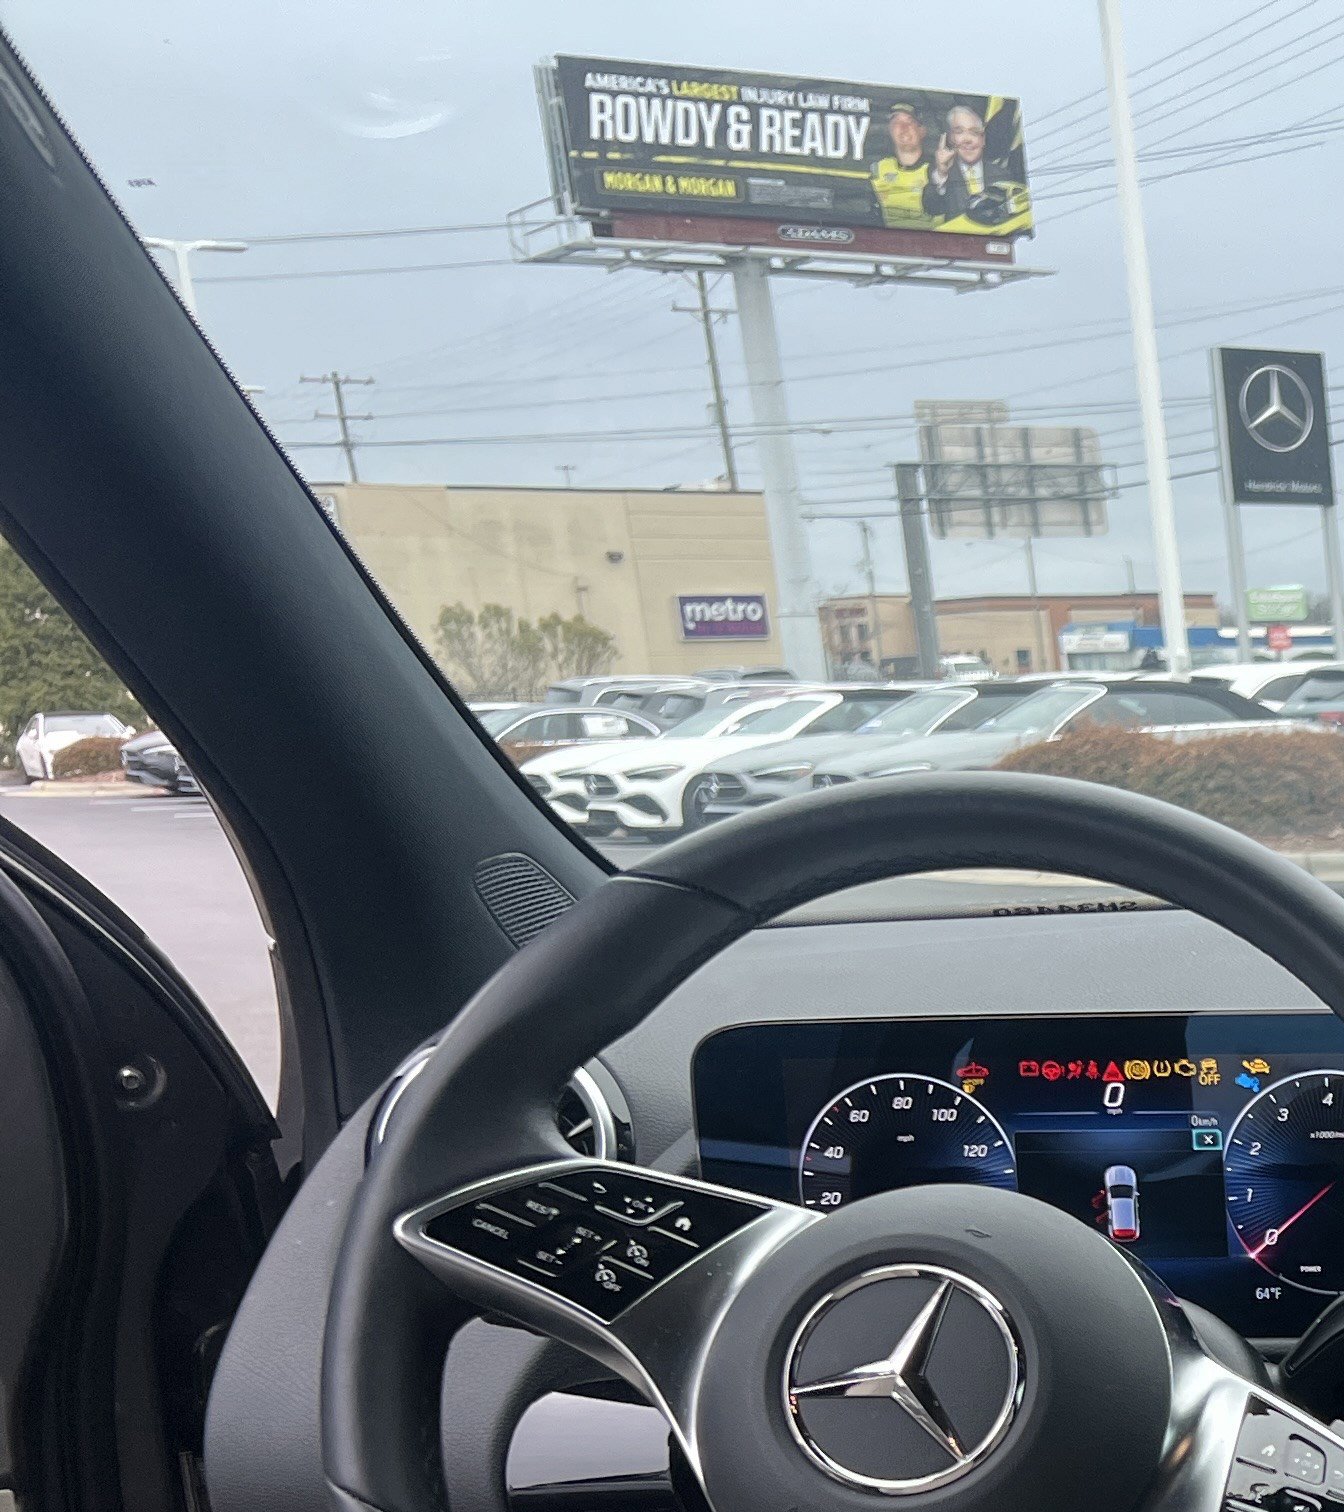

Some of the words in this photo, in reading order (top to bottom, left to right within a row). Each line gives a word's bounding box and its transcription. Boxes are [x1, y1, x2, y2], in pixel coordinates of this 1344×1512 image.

[671, 80, 739, 101] LARGEST
[741, 86, 796, 106] INJURY
[797, 90, 830, 109] LAW
[588, 91, 722, 150] ROWDY
[727, 104, 752, 151] &
[758, 106, 871, 161] READY
[603, 171, 664, 194] MORGAN
[665, 175, 677, 194] &
[677, 176, 737, 198] MORGAN
[682, 597, 764, 627] metro
[1198, 1073, 1221, 1086] OFF
[1103, 1082, 1126, 1108] 0
[1322, 1092, 1334, 1107] 4
[891, 1096, 913, 1110] 80
[849, 1109, 870, 1123] 60
[931, 1108, 958, 1122] 100
[1277, 1107, 1290, 1122] 3
[823, 1146, 845, 1159] 40
[962, 1144, 988, 1158] 120
[1249, 1141, 1262, 1156] 2
[819, 1191, 842, 1206] 20
[1246, 1187, 1254, 1203] 1
[471, 1218, 510, 1240] CANCEL
[1264, 1228, 1279, 1246] 0
[1255, 1287, 1282, 1300] 64°F
